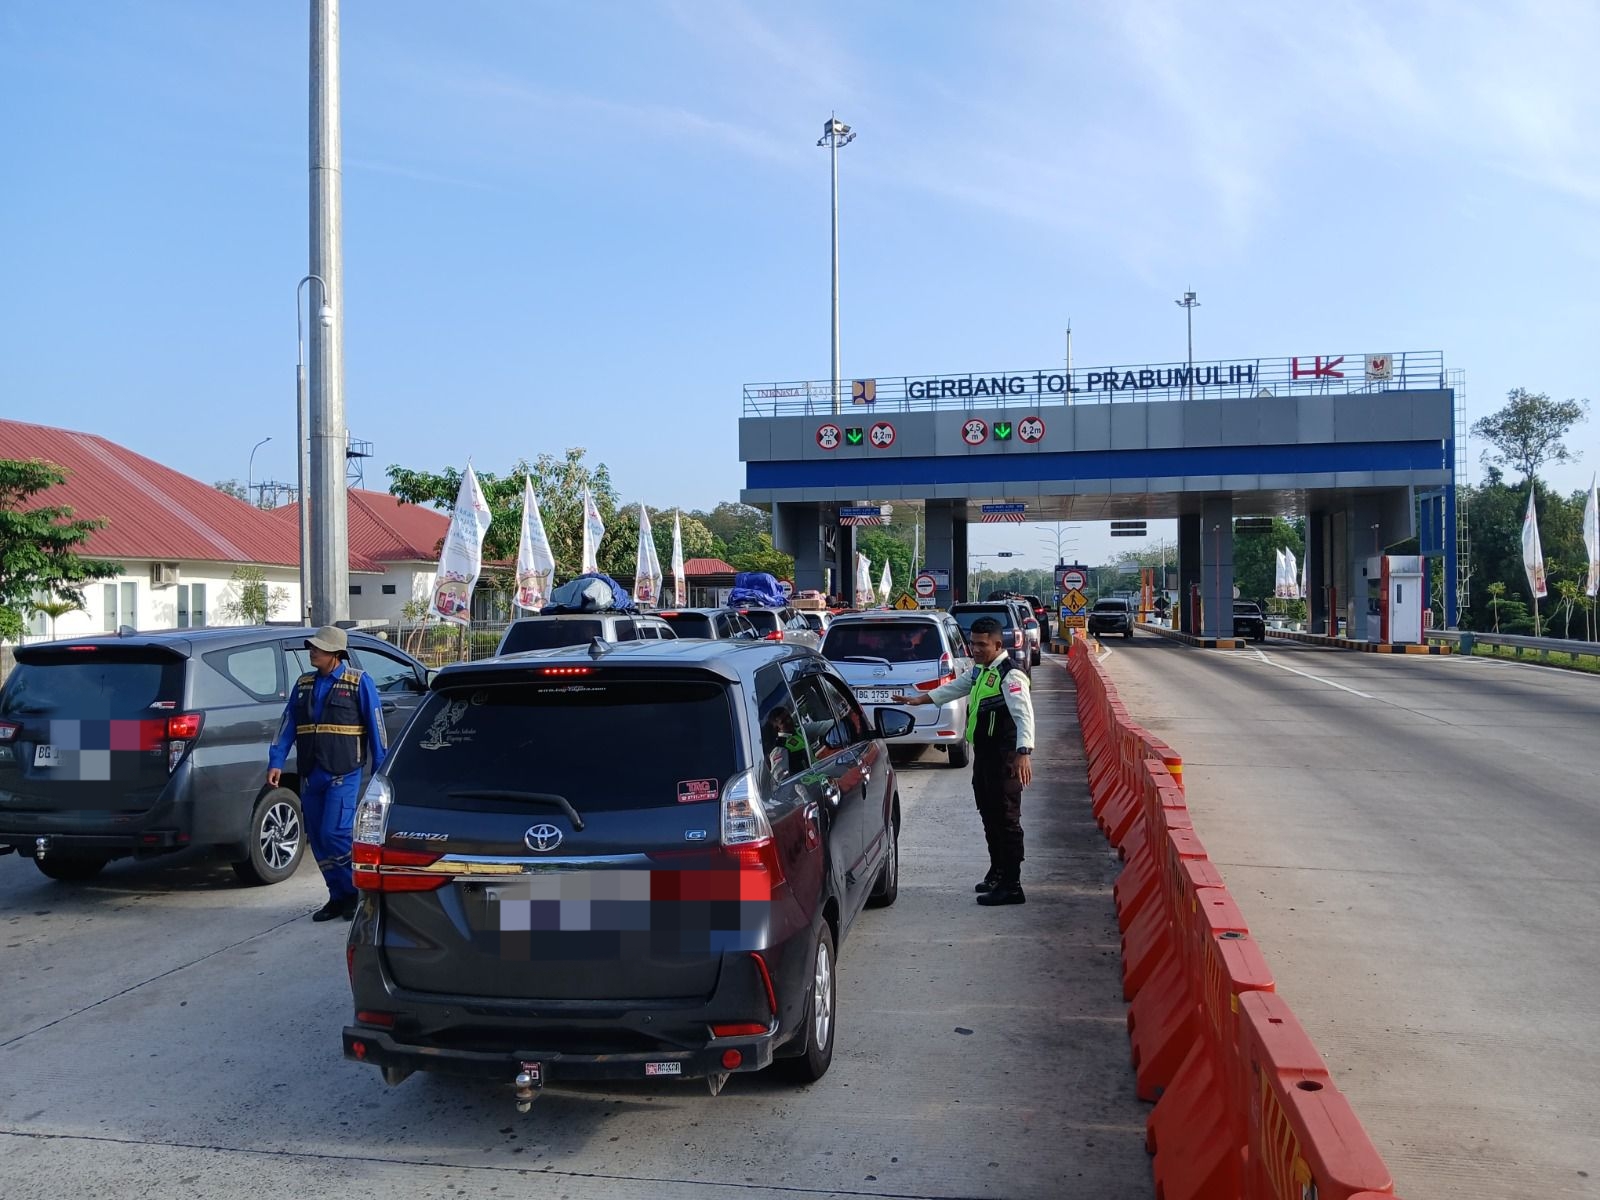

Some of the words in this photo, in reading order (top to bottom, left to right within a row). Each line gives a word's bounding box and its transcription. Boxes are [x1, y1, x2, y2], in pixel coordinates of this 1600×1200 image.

[1292, 355, 1345, 380] HK
[908, 376, 1025, 399] GERBANG
[1032, 373, 1080, 394] TOL
[1087, 364, 1253, 393] PRABUMULIH
[823, 428, 835, 438] 2,5
[969, 423, 981, 434] 2,5
[38, 746, 51, 759] BG
[391, 831, 449, 842] AVANZA
